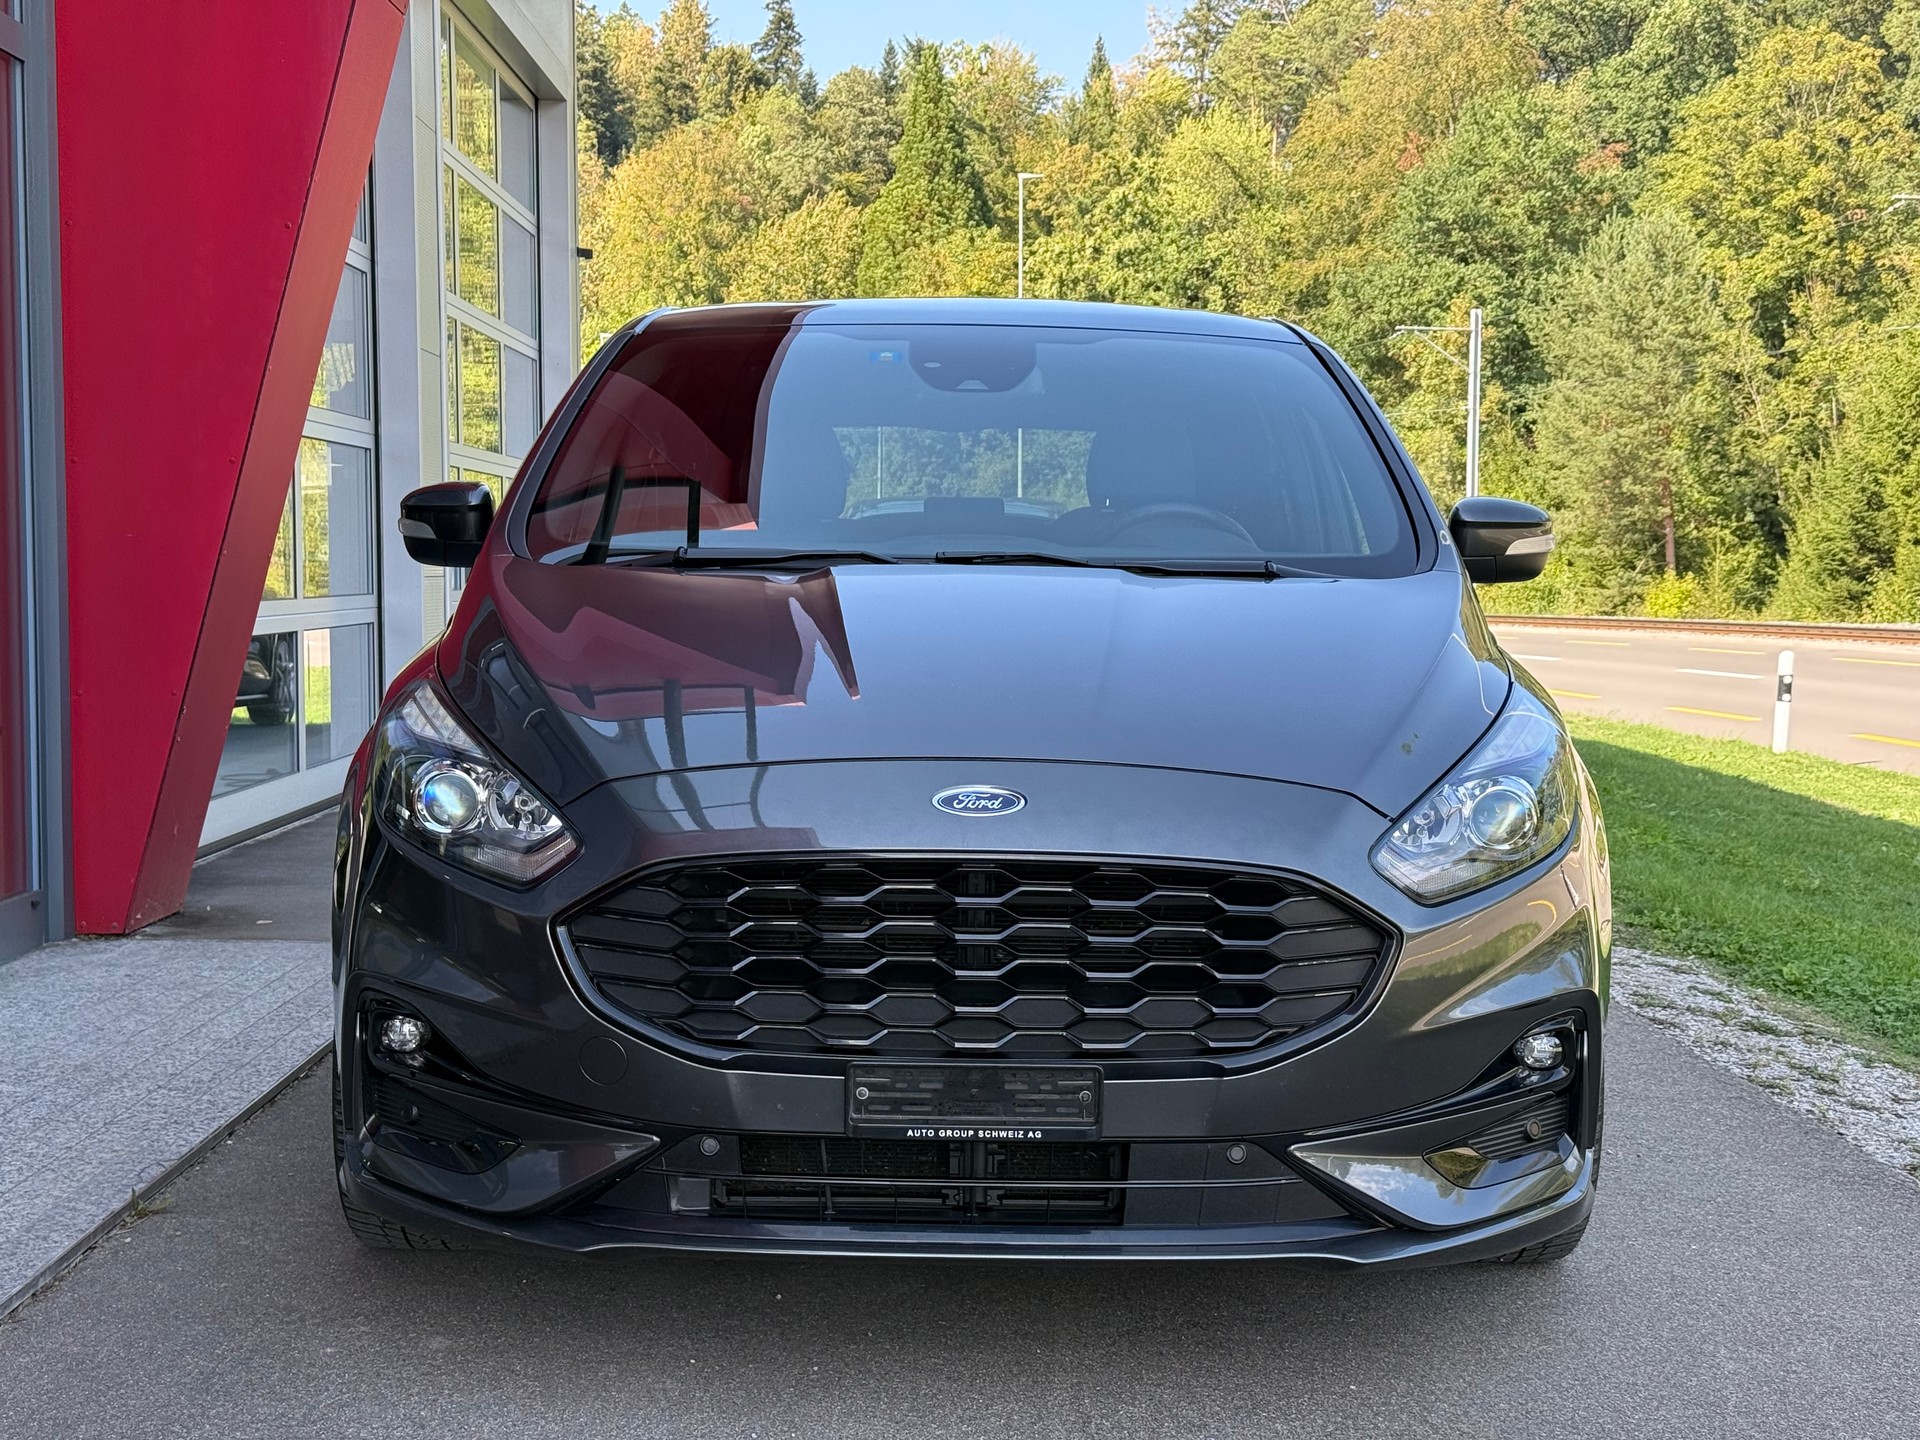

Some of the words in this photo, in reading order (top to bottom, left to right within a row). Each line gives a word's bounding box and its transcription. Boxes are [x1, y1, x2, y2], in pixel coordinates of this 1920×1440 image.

[953, 793, 1004, 809] Ford
[906, 1129, 935, 1137] AUTO
[938, 1129, 974, 1138] GROUP
[978, 1130, 1024, 1138] SCHWEIZ
[1028, 1130, 1042, 1139] AG
